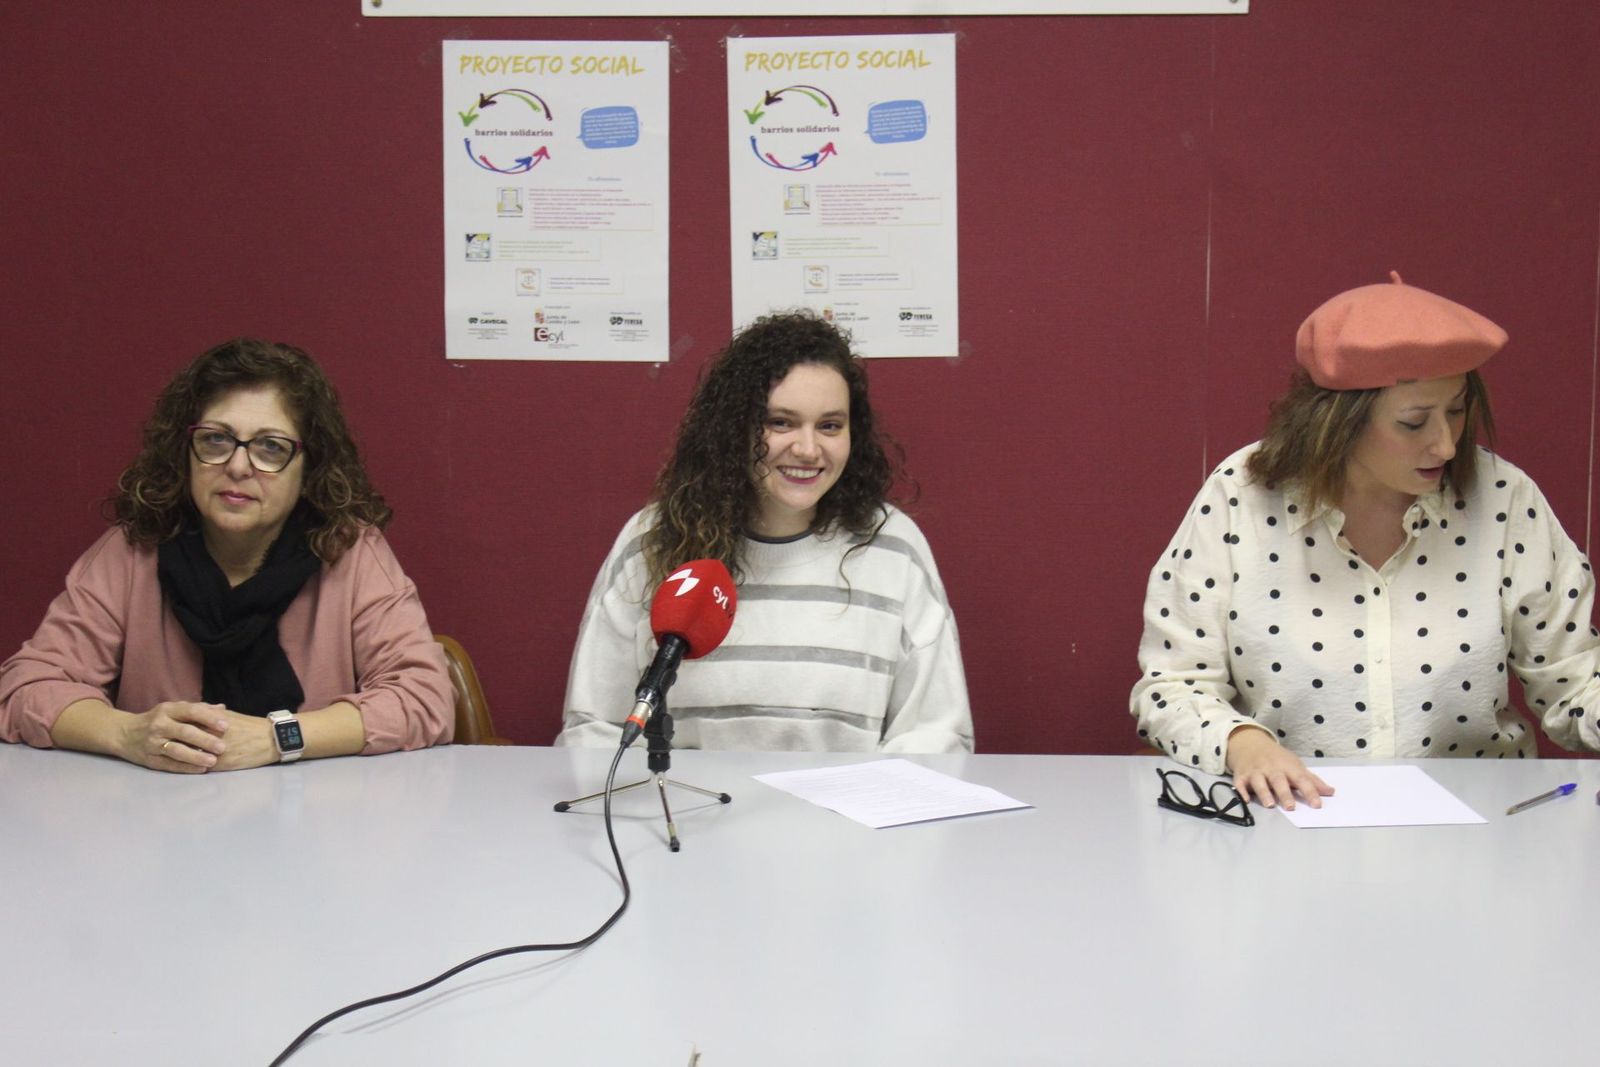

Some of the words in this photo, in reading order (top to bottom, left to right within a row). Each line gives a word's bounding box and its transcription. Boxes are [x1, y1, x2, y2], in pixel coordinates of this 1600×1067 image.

[460, 54, 563, 77] PROYECTO
[570, 53, 645, 75] SOCIAL
[744, 51, 850, 73] PROYECTO
[857, 48, 932, 70] SOCIAL
[475, 128, 508, 138] barrios
[510, 128, 554, 138] solidarios
[761, 126, 793, 134] barrios
[796, 125, 840, 134] solidarios
